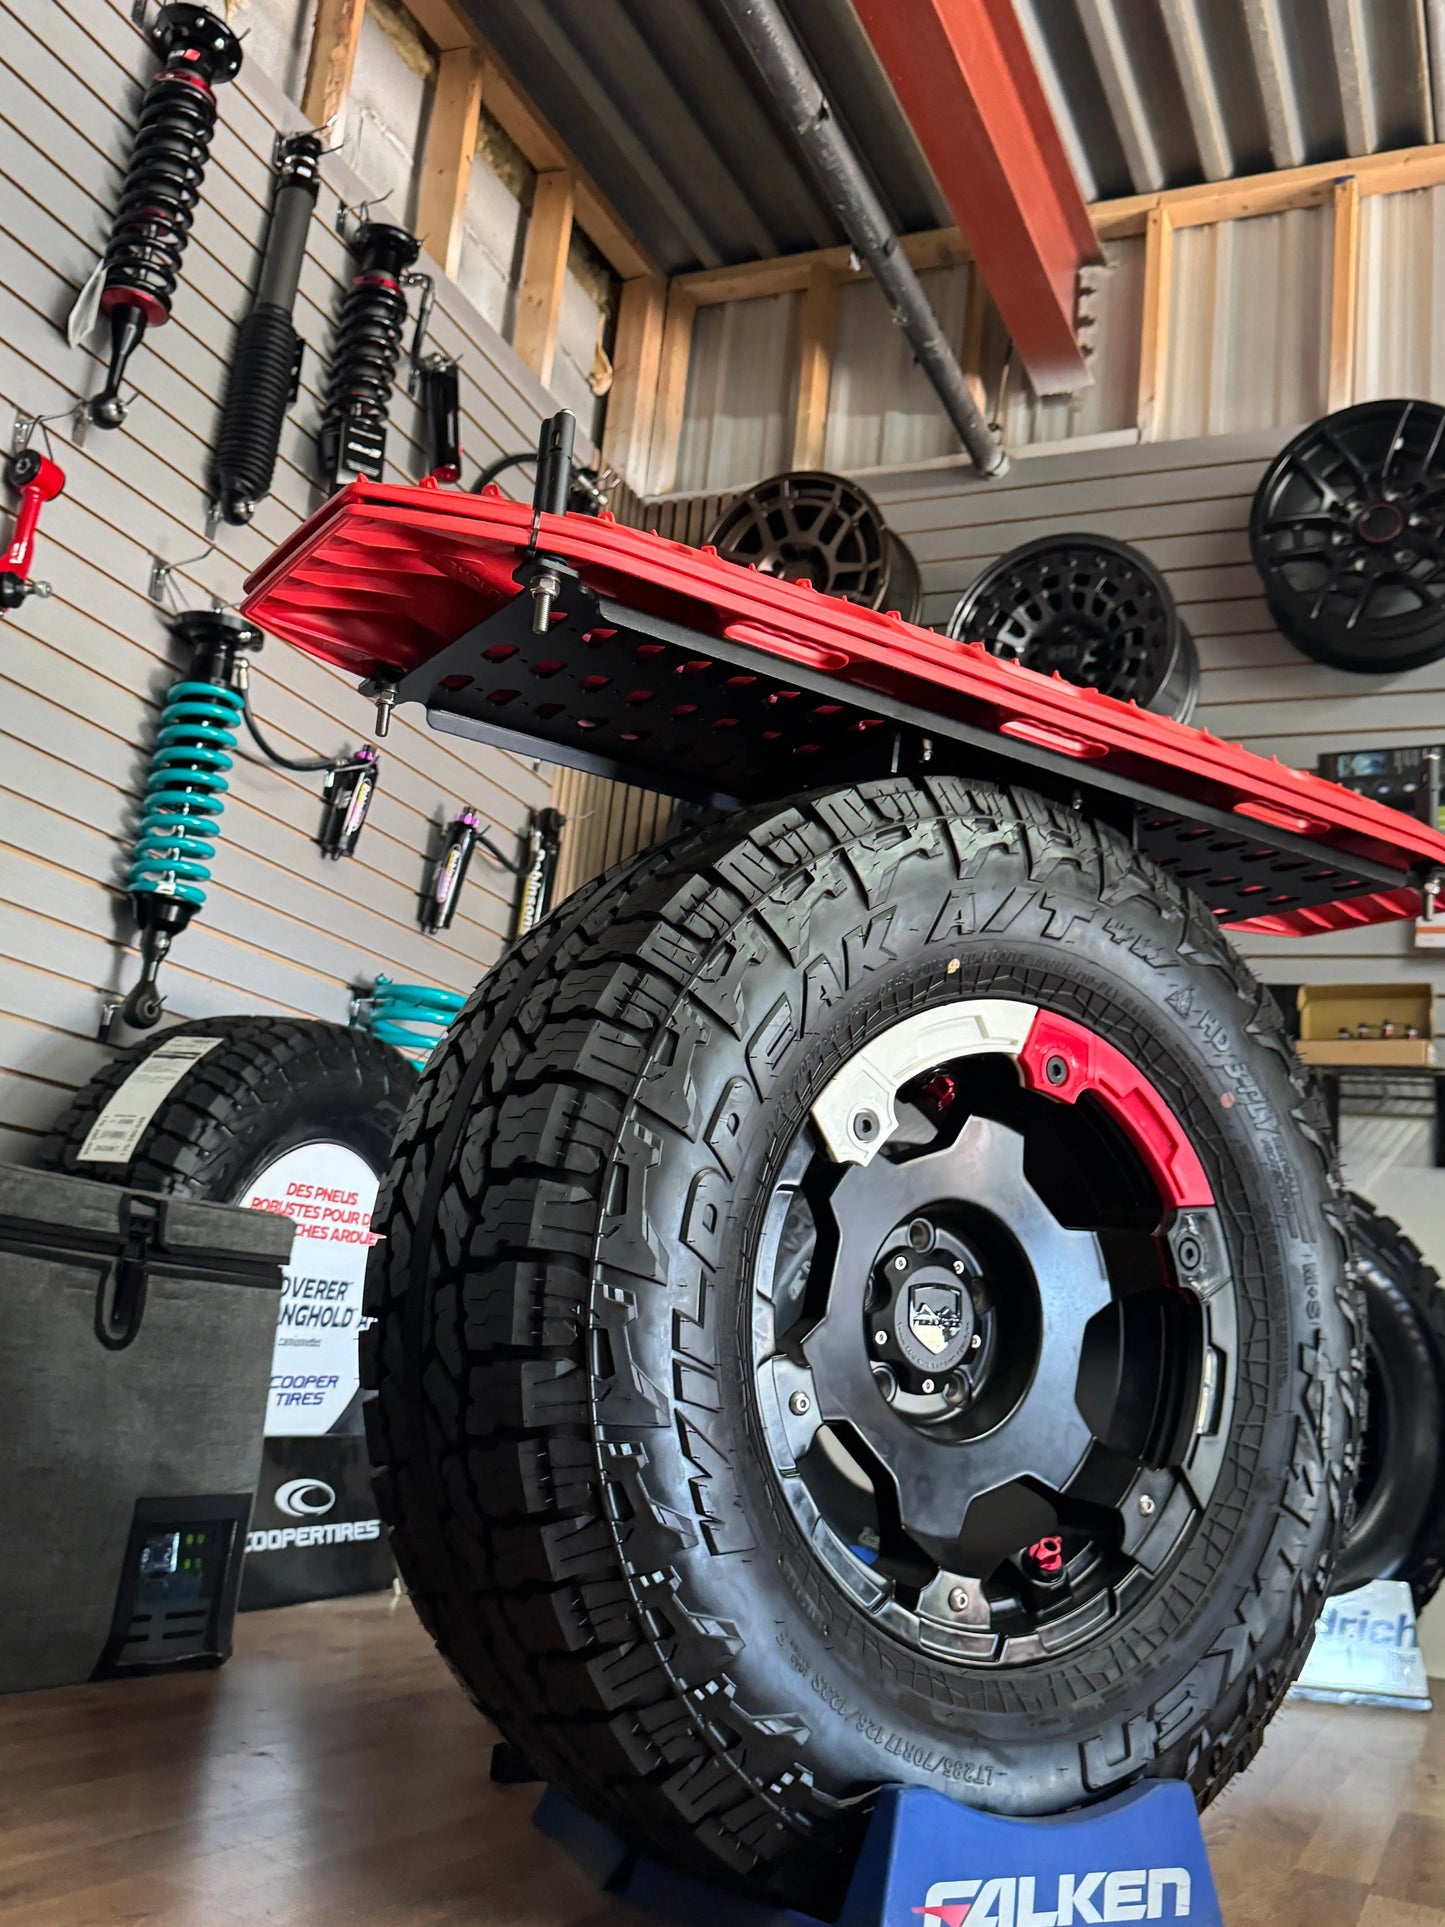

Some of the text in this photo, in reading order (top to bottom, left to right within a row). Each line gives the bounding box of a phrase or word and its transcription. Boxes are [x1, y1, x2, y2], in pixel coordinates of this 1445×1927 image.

[286, 1182, 359, 1206] DES PNEUS
[251, 1197, 320, 1220] ROBUSTES
[321, 1207, 360, 1225] POUR
[270, 1375, 340, 1389] COOPER
[276, 1392, 326, 1406] TIRES
[884, 1731, 995, 1787] LT285/70R17
[920, 1867, 1191, 1927] FALKEN
